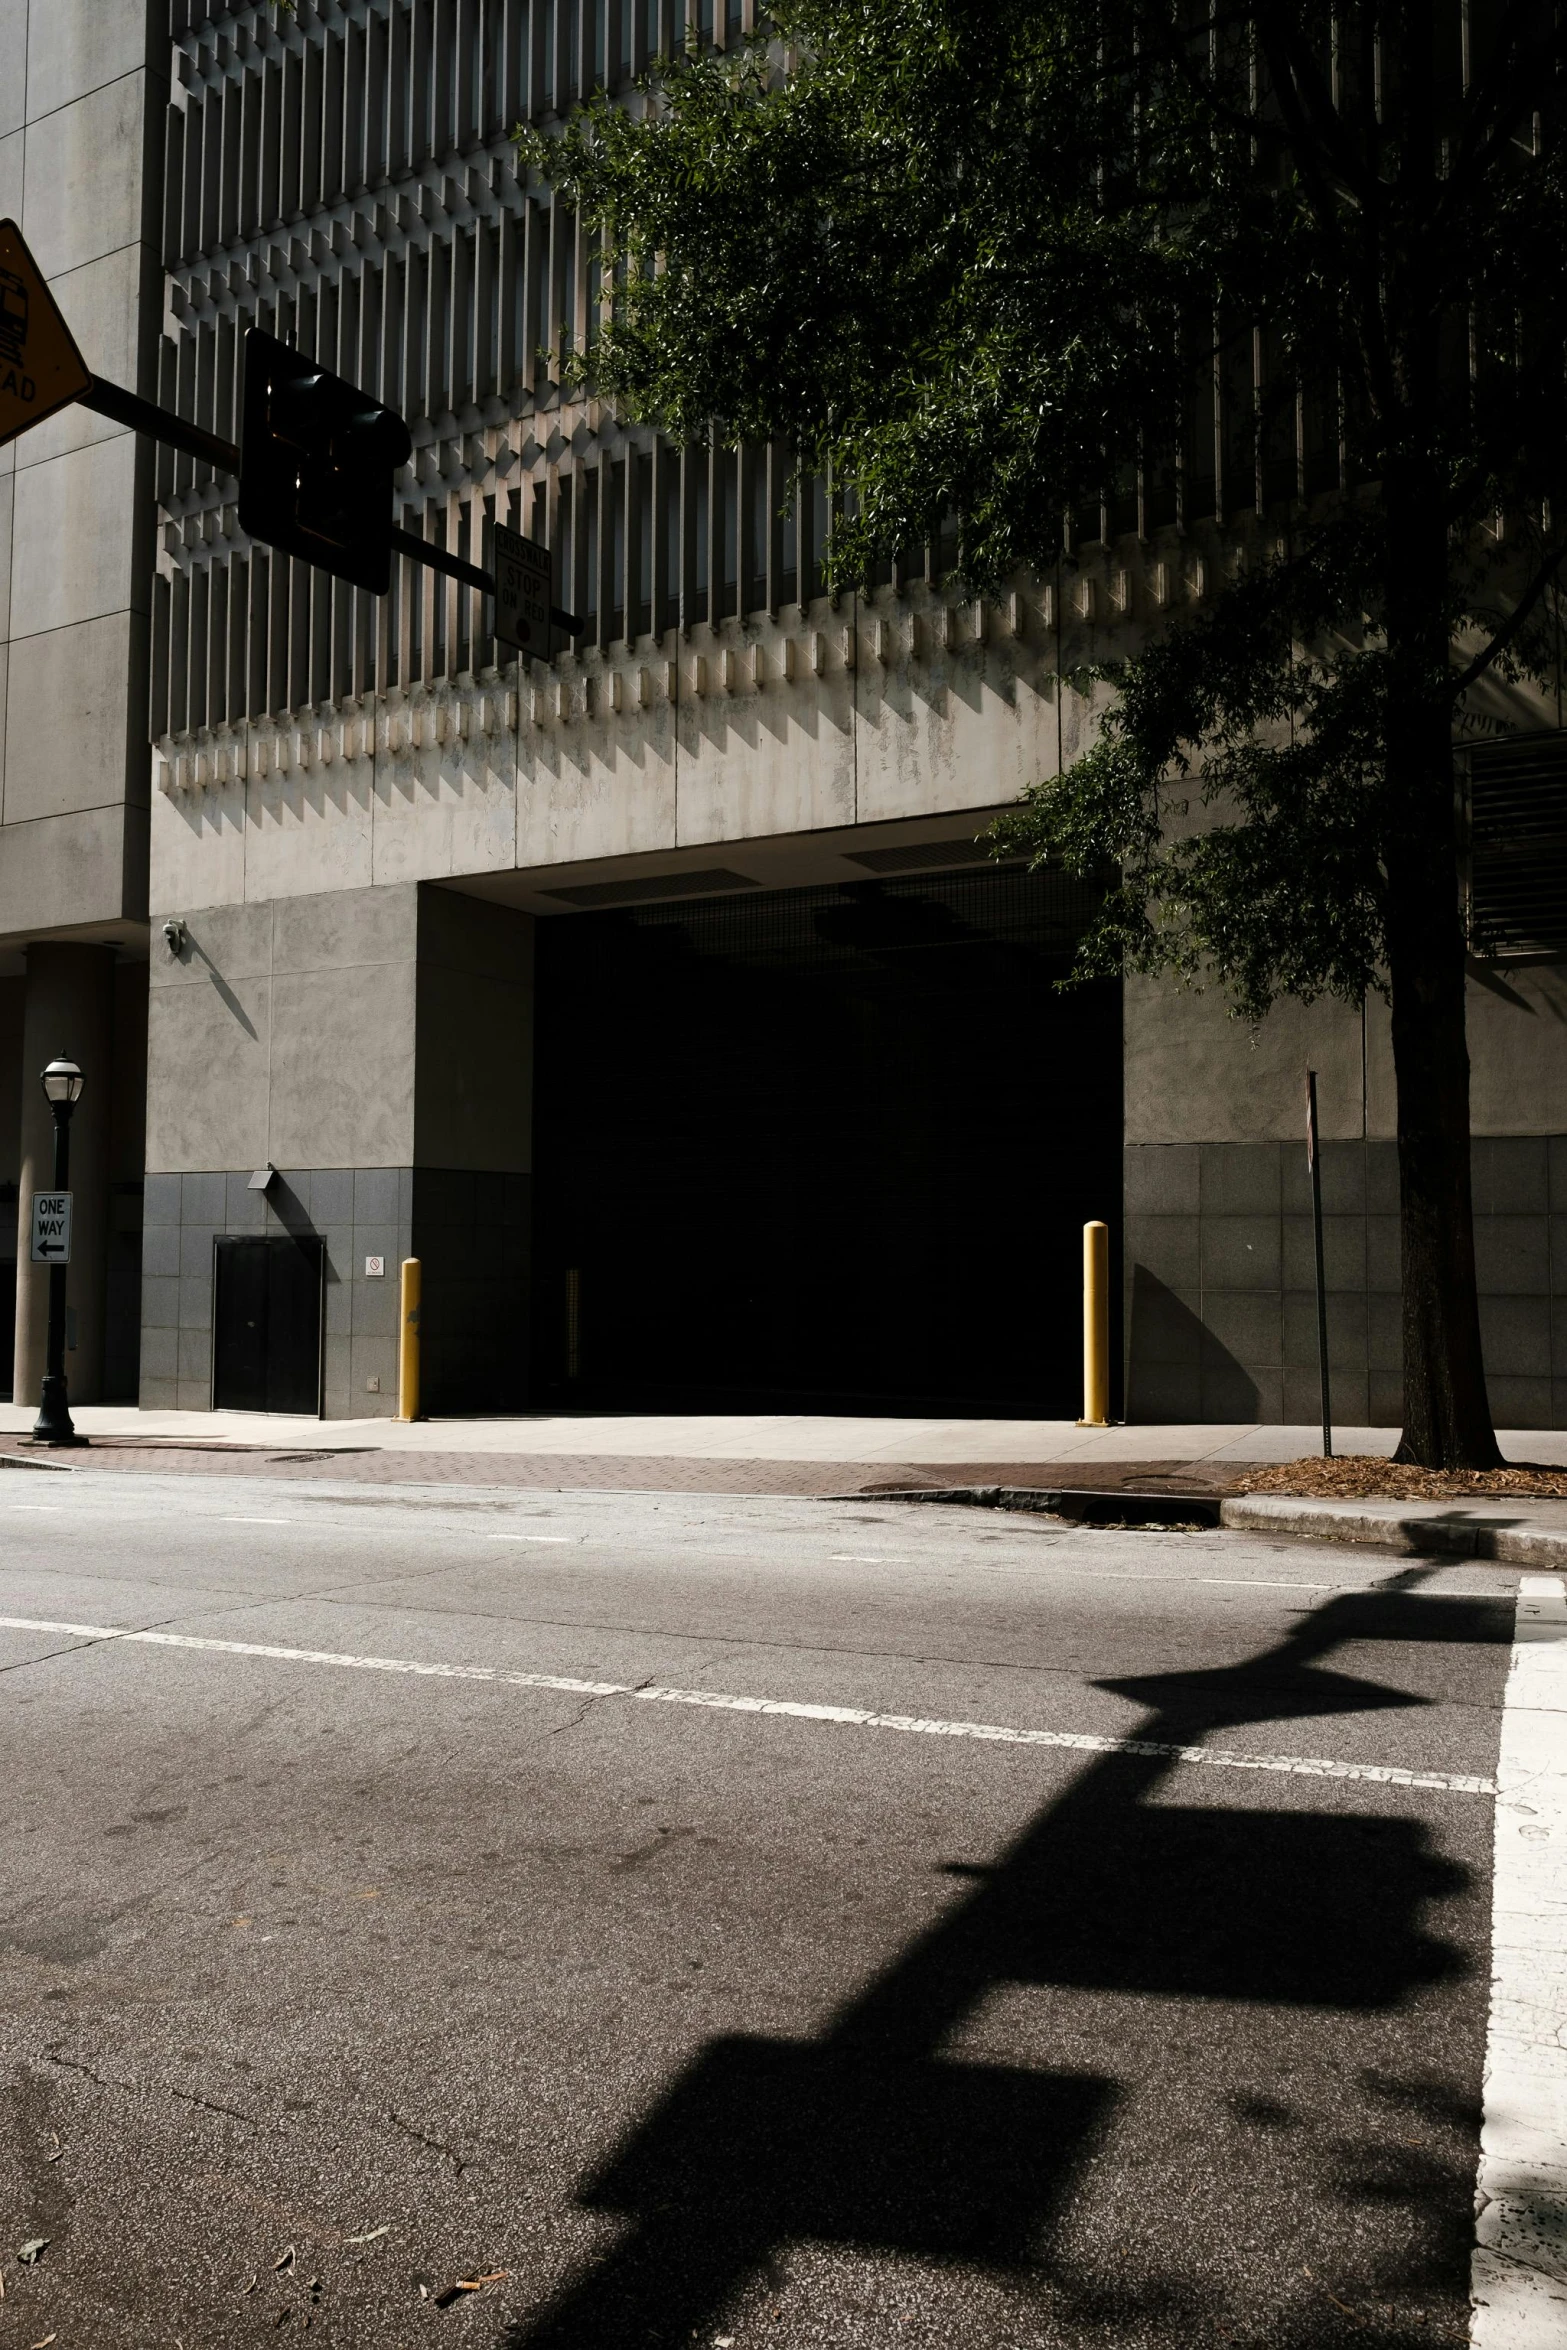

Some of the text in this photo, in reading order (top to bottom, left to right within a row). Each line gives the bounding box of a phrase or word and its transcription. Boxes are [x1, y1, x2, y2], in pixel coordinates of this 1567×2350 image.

[0, 366, 36, 402] AD
[498, 530, 549, 573] CROSSWALK
[507, 565, 541, 598] STOP
[502, 588, 545, 624] ON RED
[39, 1199, 65, 1215] ONE
[38, 1220, 65, 1236] WAY
